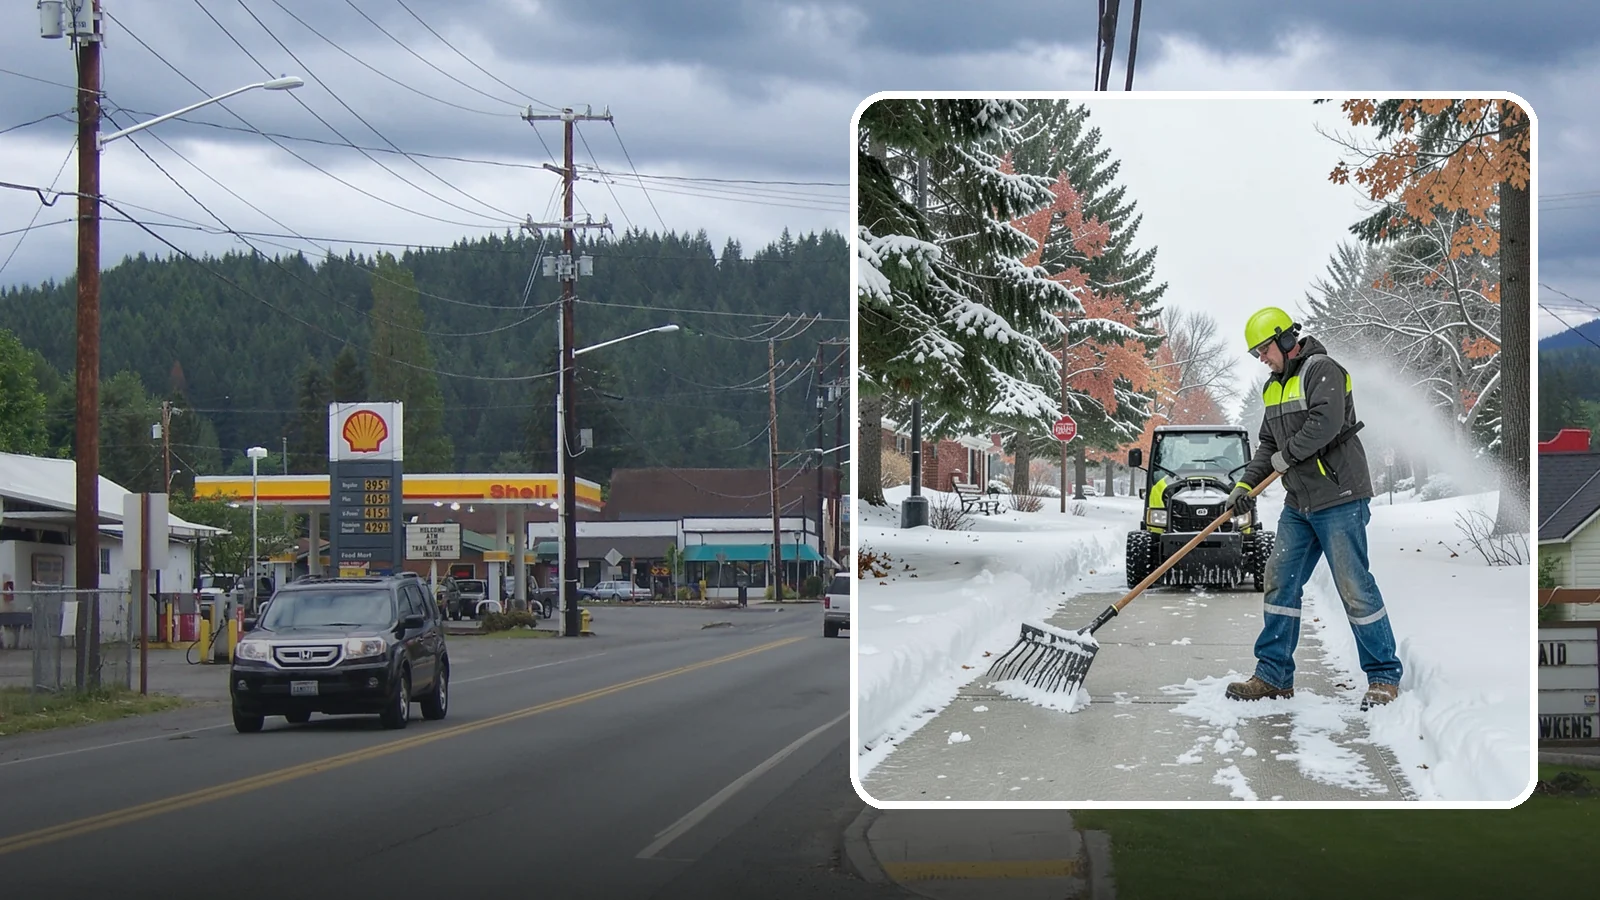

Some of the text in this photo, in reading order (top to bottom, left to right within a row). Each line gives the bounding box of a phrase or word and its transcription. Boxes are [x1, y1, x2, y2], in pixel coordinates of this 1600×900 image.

[366, 480, 383, 490] 395
[490, 485, 547, 499] Shell
[366, 494, 383, 504] 405
[366, 508, 383, 518] 415
[366, 522, 383, 533] 429
